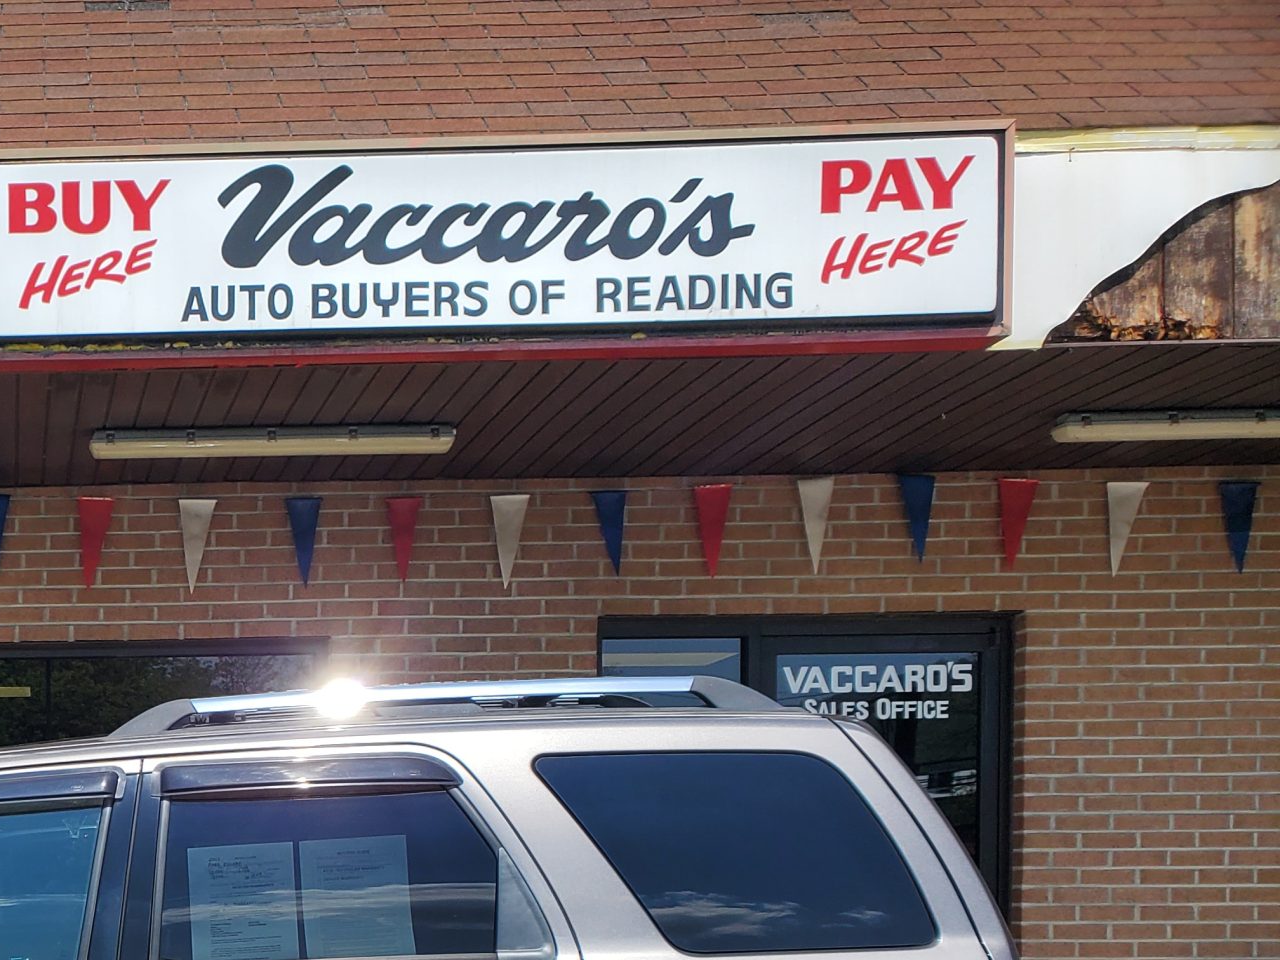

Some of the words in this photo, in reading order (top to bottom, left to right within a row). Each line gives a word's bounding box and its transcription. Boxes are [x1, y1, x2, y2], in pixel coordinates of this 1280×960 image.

[7, 180, 169, 235] BUY
[820, 156, 973, 214] PAY
[218, 164, 755, 268] Vaccaro's
[19, 240, 156, 310] HERE
[821, 220, 964, 284] HERE
[181, 283, 294, 322] AUTO
[311, 281, 489, 318] BUYERS
[510, 280, 564, 316] OF
[597, 273, 793, 313] READING
[783, 661, 973, 694] VACCARO'S
[804, 698, 870, 720] SALES
[876, 698, 950, 720] OFFICE
